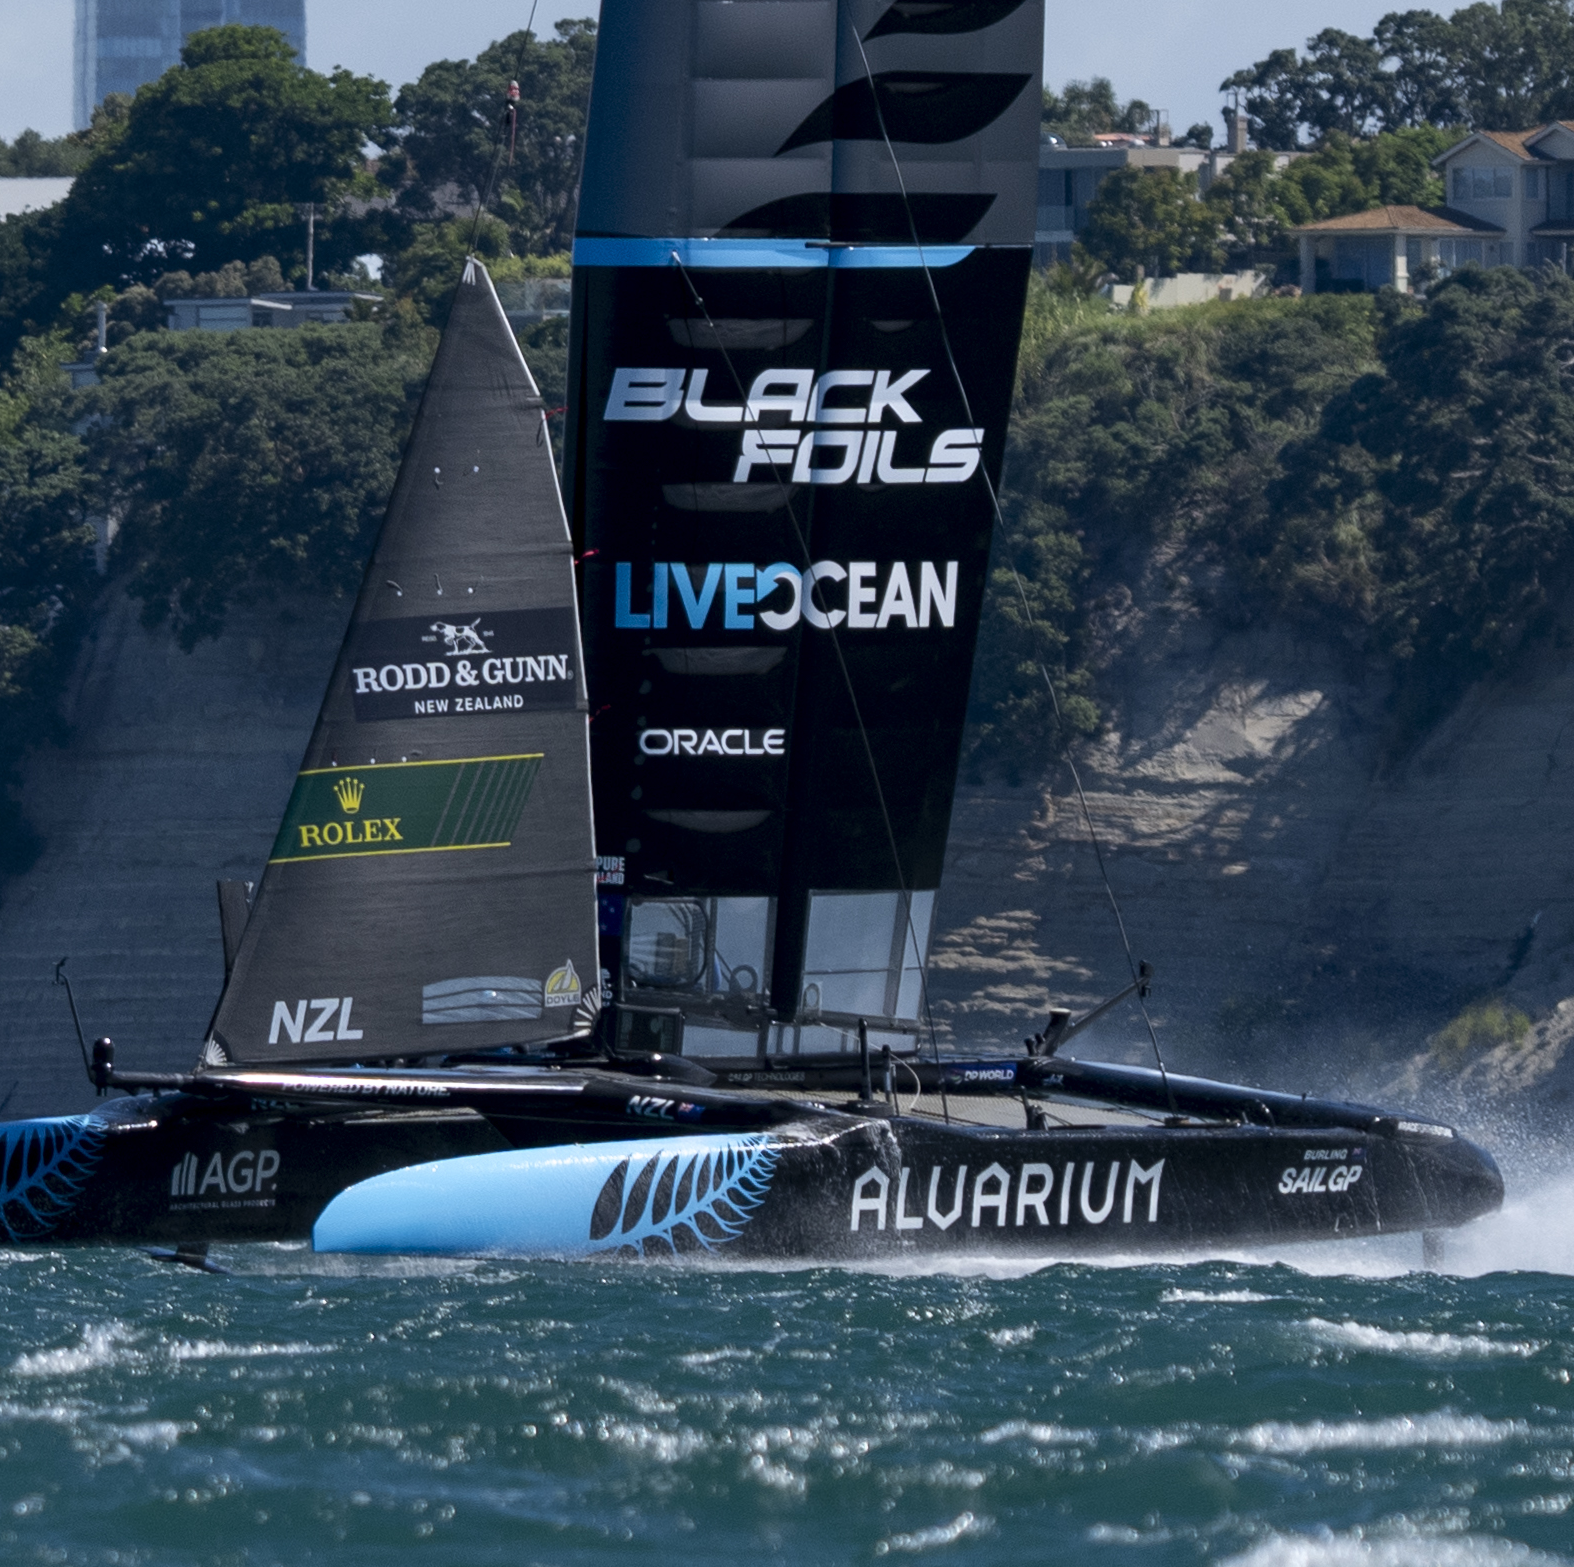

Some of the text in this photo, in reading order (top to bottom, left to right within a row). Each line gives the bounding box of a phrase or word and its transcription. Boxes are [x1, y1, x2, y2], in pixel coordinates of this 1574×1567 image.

[603, 367, 931, 422] BLACK
[733, 428, 985, 484] FOILS
[352, 654, 568, 694] RODD & GUNN
[414, 694, 524, 714] NEW ZEALAND
[639, 729, 786, 755] ORACLE
[298, 817, 404, 848] ROLEX
[547, 994, 579, 1005] DOYLE
[268, 997, 364, 1045] NZL
[754, 1071, 806, 1082] TECHNOLOGIES
[979, 1069, 1015, 1081] WORLD
[282, 1083, 362, 1094] POWERED
[362, 1084, 384, 1095] BY
[627, 1095, 675, 1120] NZL
[1303, 1148, 1348, 1161] BURLING
